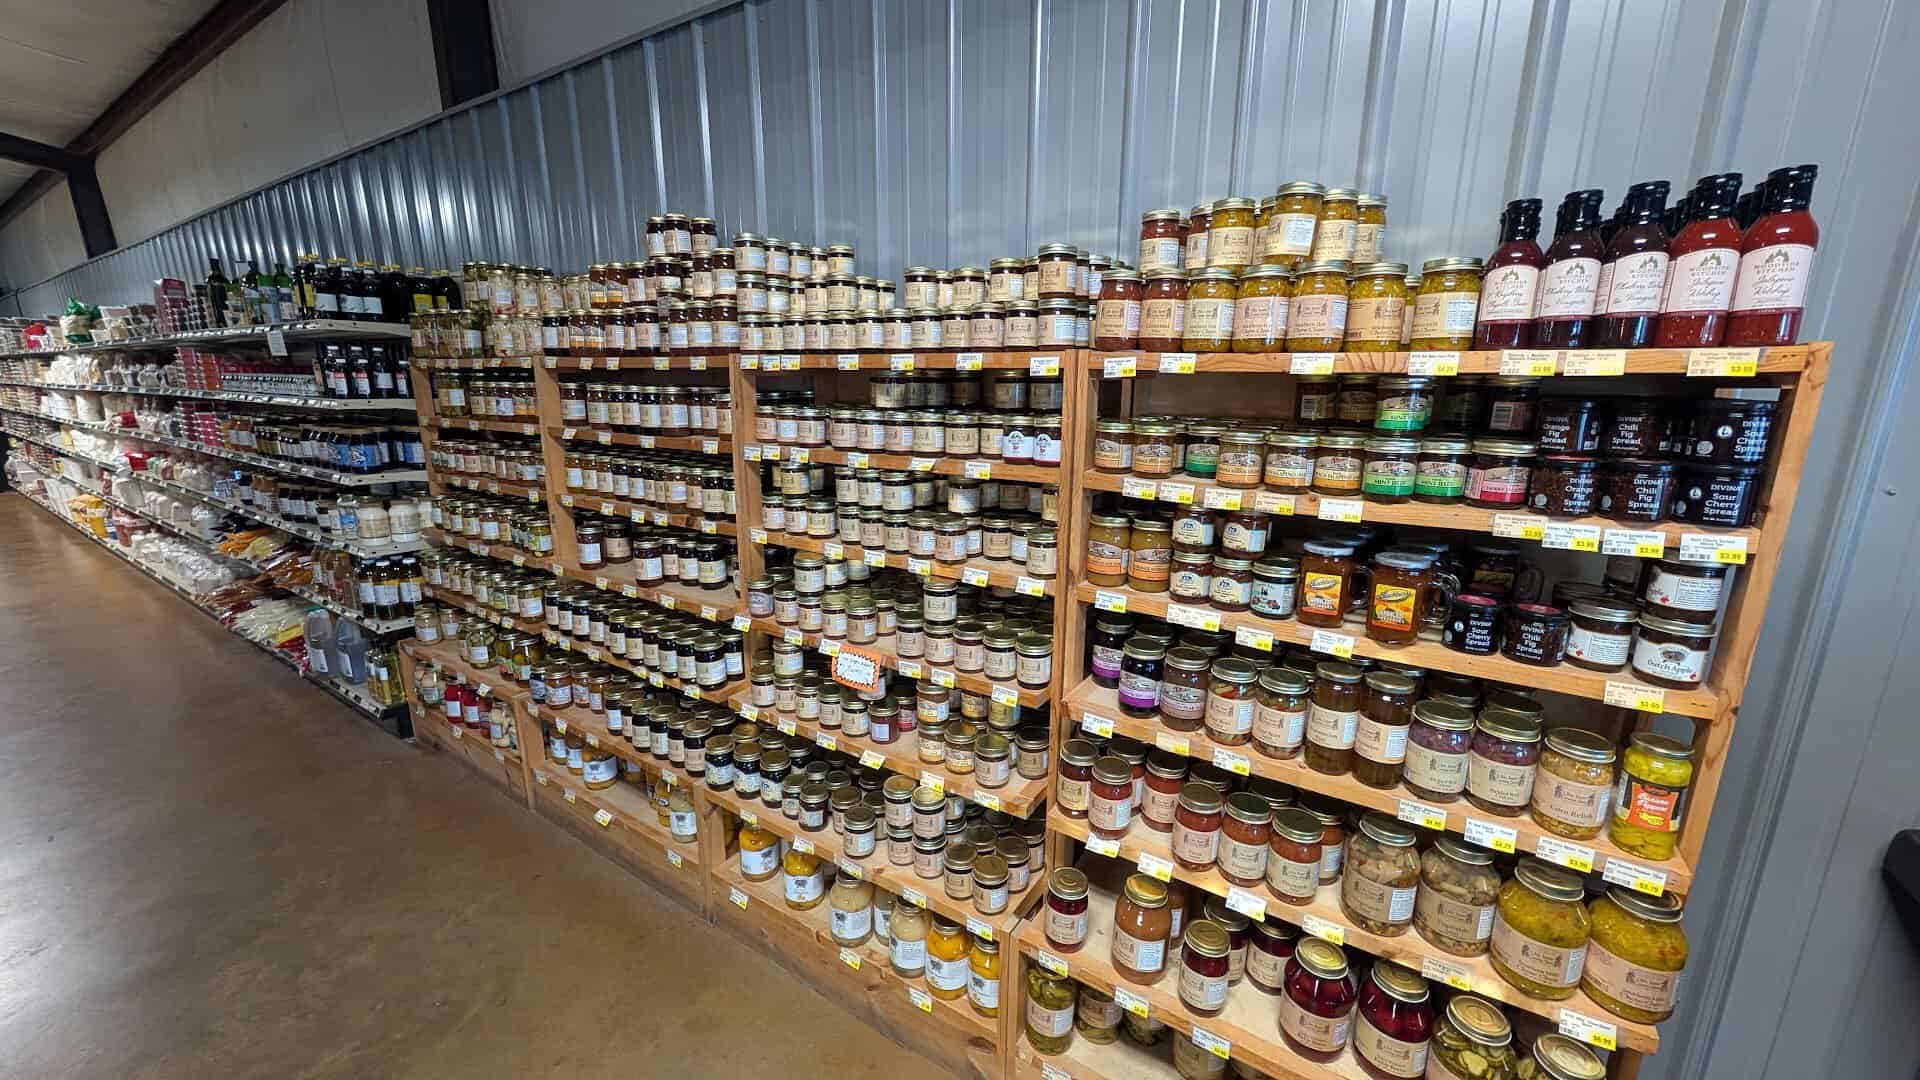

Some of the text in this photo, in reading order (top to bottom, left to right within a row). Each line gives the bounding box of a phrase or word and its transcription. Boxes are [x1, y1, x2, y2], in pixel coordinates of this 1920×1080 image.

[1543, 423, 1571, 432] Orange
[1618, 423, 1640, 431] Chili
[1548, 430, 1561, 438] Fig
[1620, 431, 1634, 439] Fig
[1743, 429, 1765, 437] Sour
[1541, 435, 1568, 445] Spread
[1612, 436, 1642, 446] Spread
[1736, 437, 1768, 446] Cherry
[1734, 444, 1767, 454] Spread
[1635, 486, 1657, 495] Chili
[1572, 492, 1586, 501] Fig
[1638, 493, 1653, 503] Fig
[1712, 492, 1737, 501] Sour
[1562, 498, 1591, 508] Spread
[1627, 500, 1660, 510] Spread
[1704, 500, 1741, 510] Cherry
[1703, 506, 1739, 517] Spread
[1471, 626, 1489, 635] Sour
[1466, 632, 1491, 642] Cherry
[1521, 632, 1542, 643] Chili
[1464, 638, 1491, 648] Spread
[1524, 639, 1538, 649] Fig
[1515, 643, 1544, 656] Spread
[1647, 658, 1672, 671] Dutch
